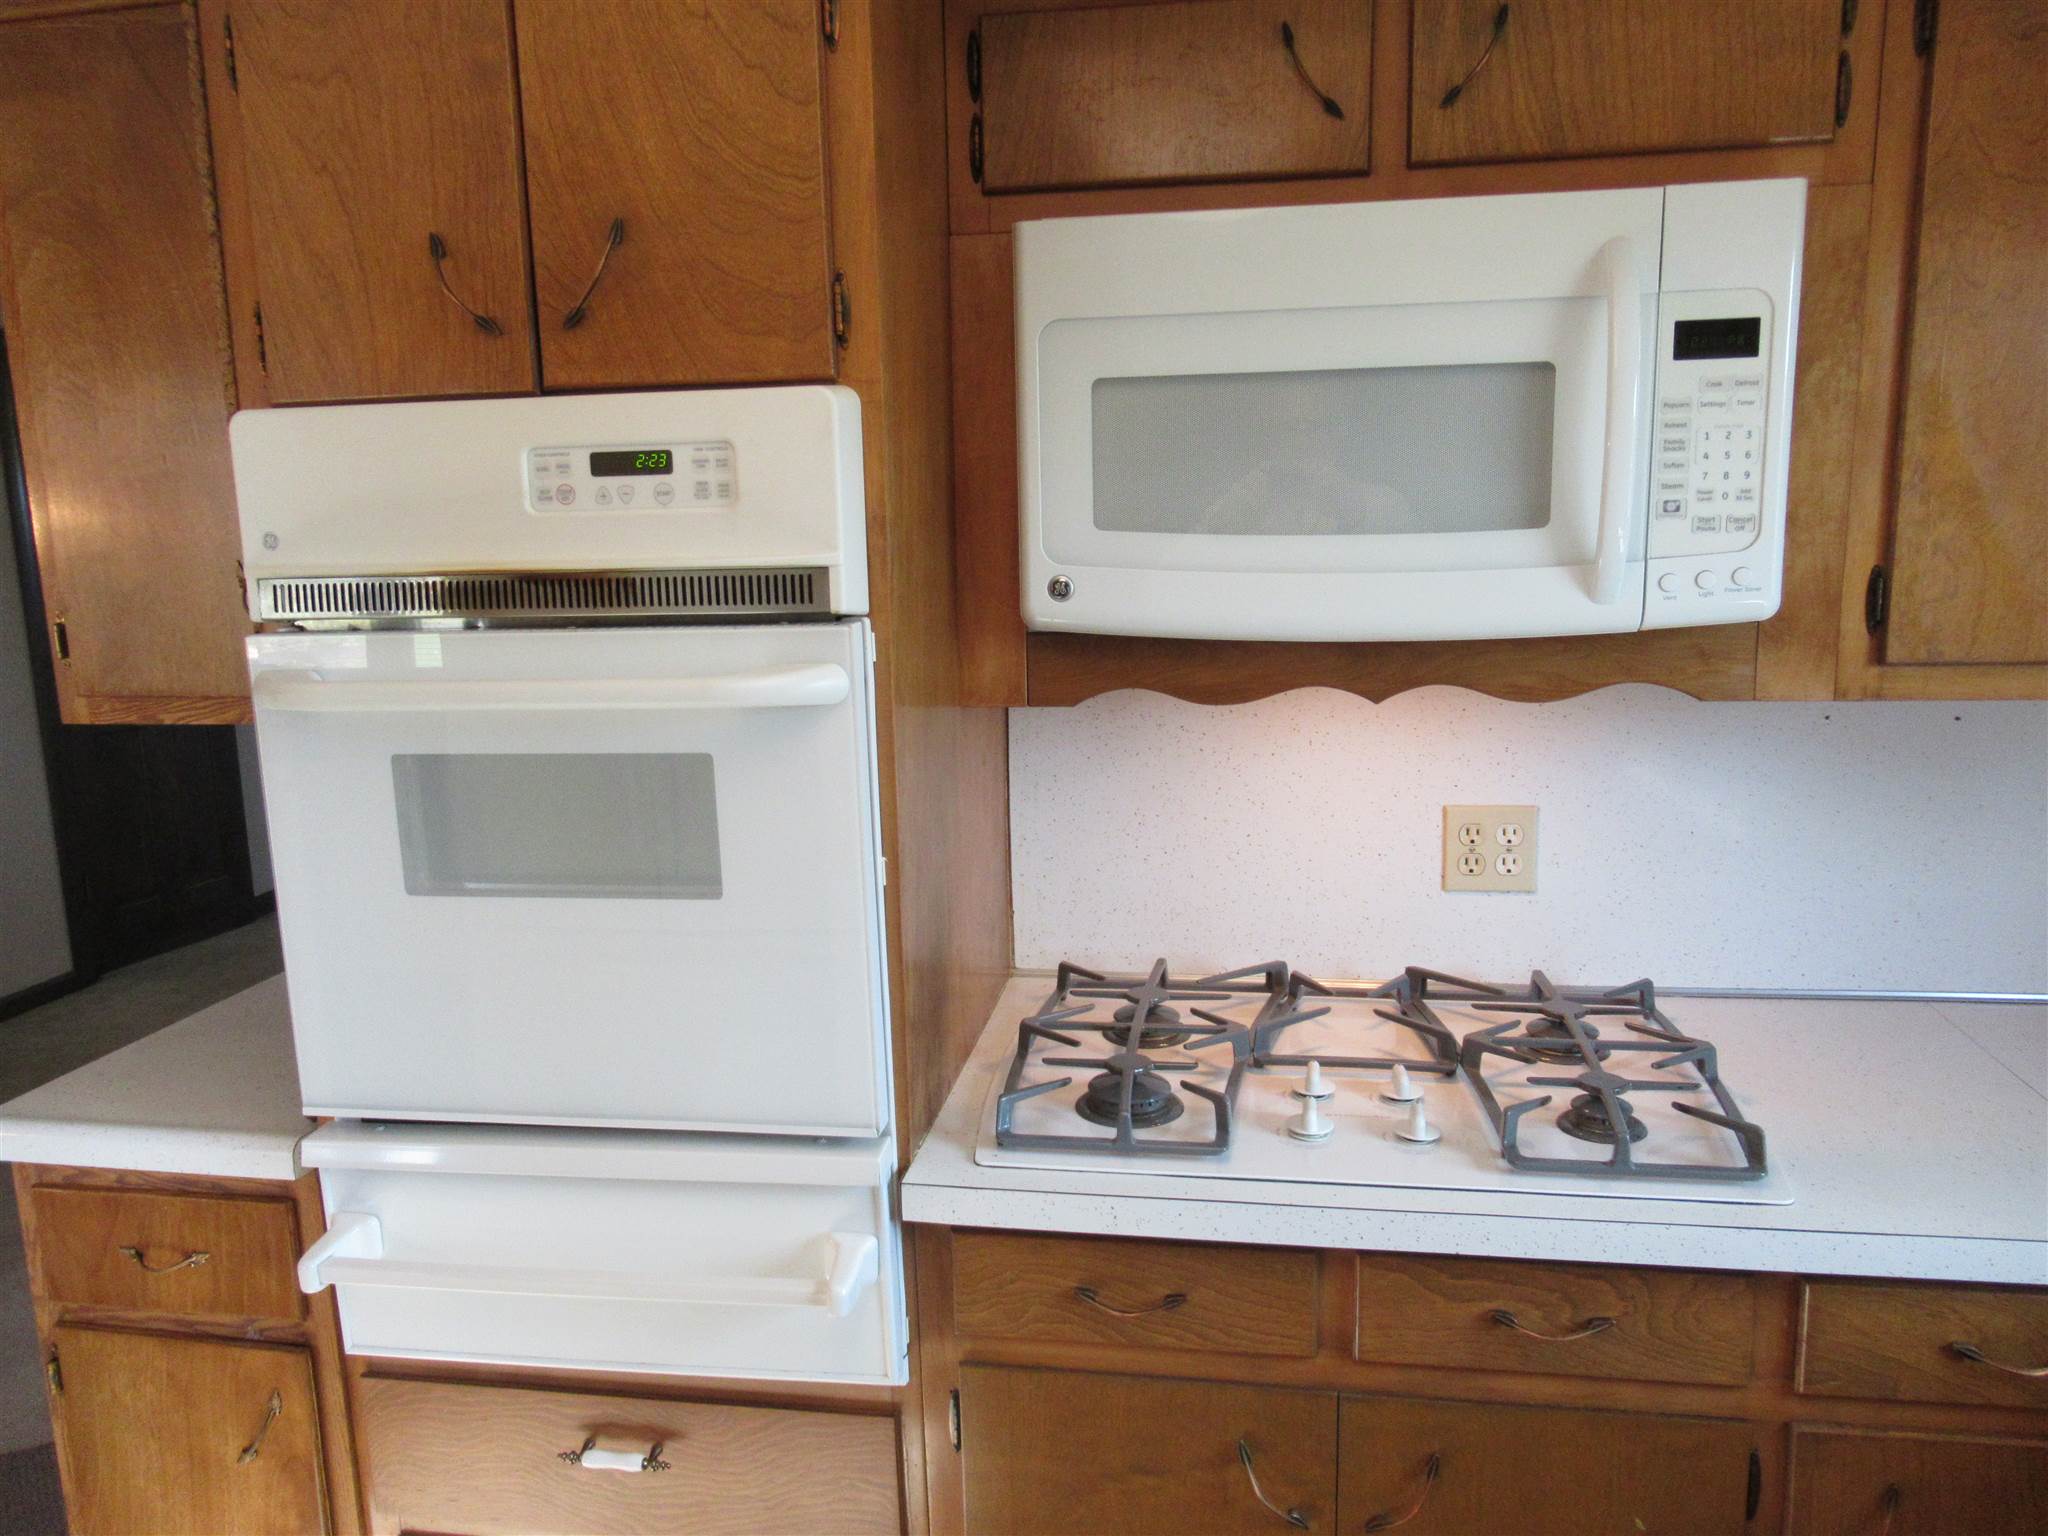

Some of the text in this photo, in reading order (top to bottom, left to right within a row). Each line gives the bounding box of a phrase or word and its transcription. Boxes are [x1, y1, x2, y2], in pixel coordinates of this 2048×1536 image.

[1704, 431, 1709, 441] 1
[1725, 430, 1731, 440] 2
[1745, 430, 1752, 439] 3
[1703, 451, 1709, 461] 4
[1724, 450, 1730, 460] 5
[1745, 450, 1751, 460] 6
[635, 453, 667, 468] 2:23
[1702, 471, 1708, 481] 7
[1723, 471, 1729, 481] 8
[1744, 470, 1750, 480] 9
[1722, 491, 1728, 500] 0
